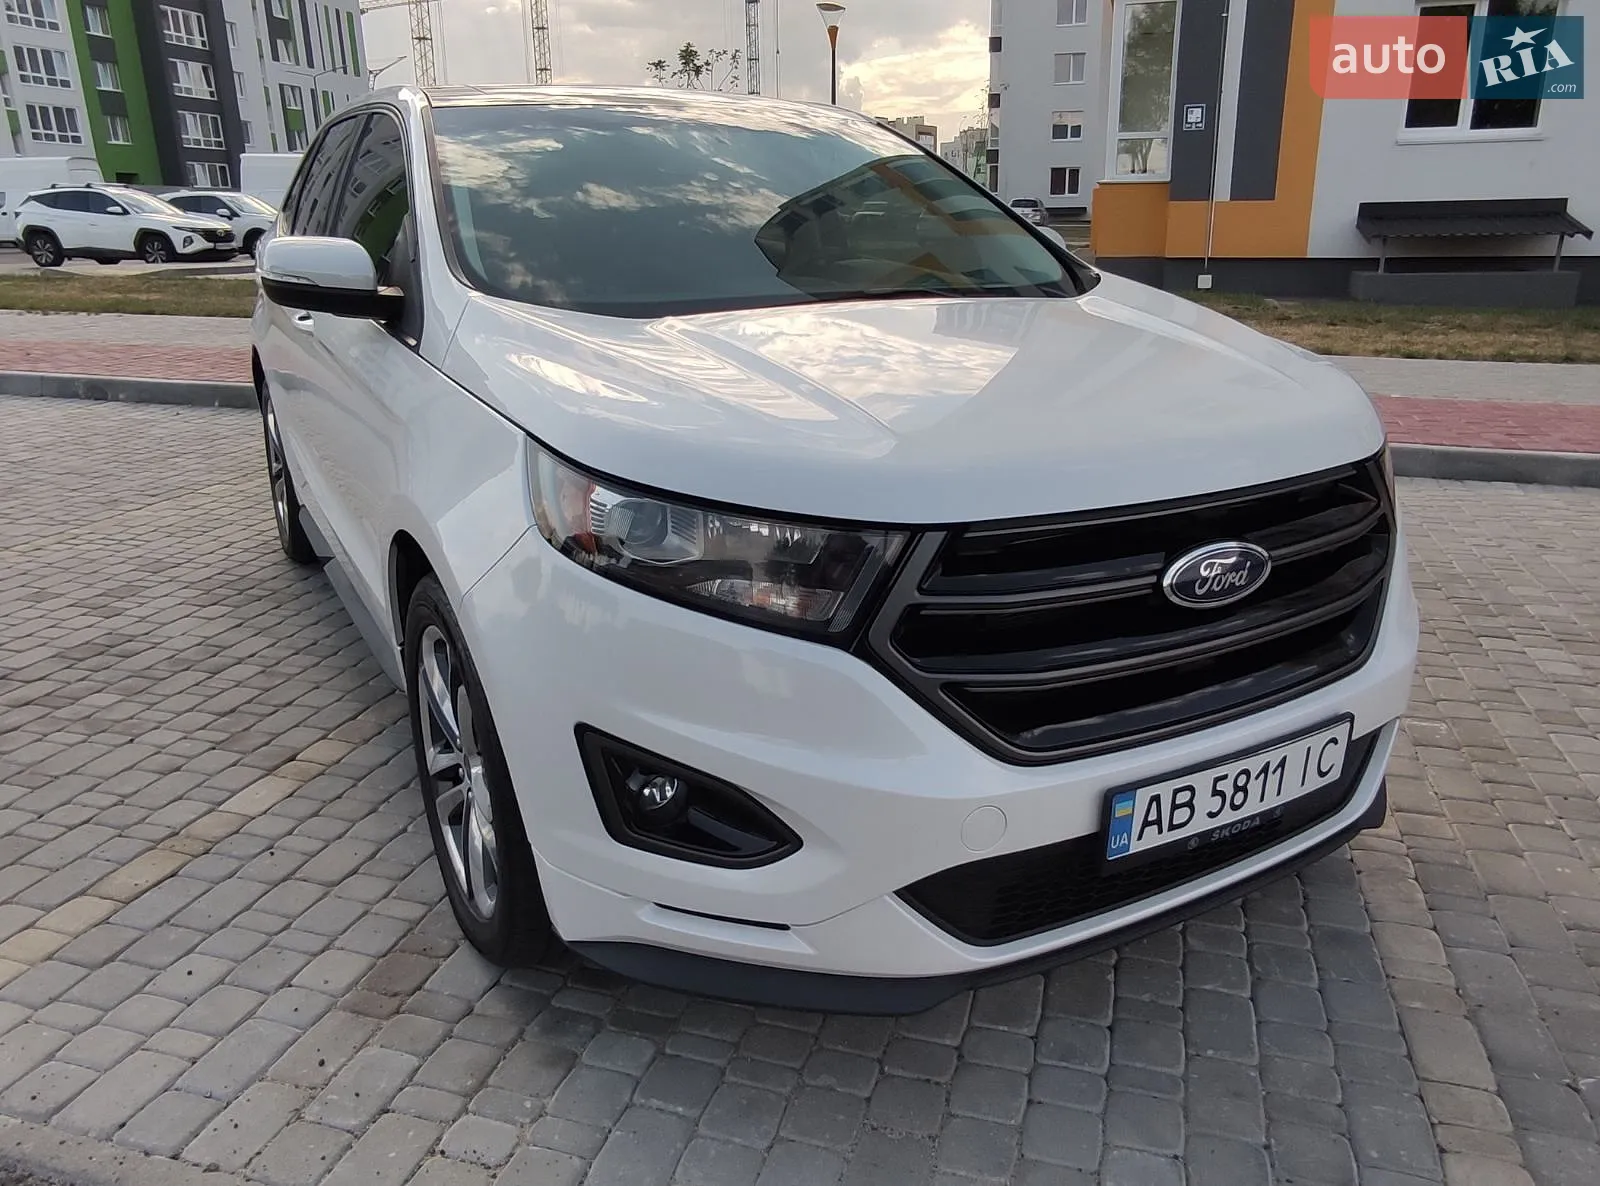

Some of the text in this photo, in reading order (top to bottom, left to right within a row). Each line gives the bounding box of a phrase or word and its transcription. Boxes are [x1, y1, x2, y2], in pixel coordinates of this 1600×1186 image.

[1194, 556, 1251, 595] Ford
[1136, 736, 1339, 841] AB 5811 IC
[1110, 835, 1129, 849] UA
